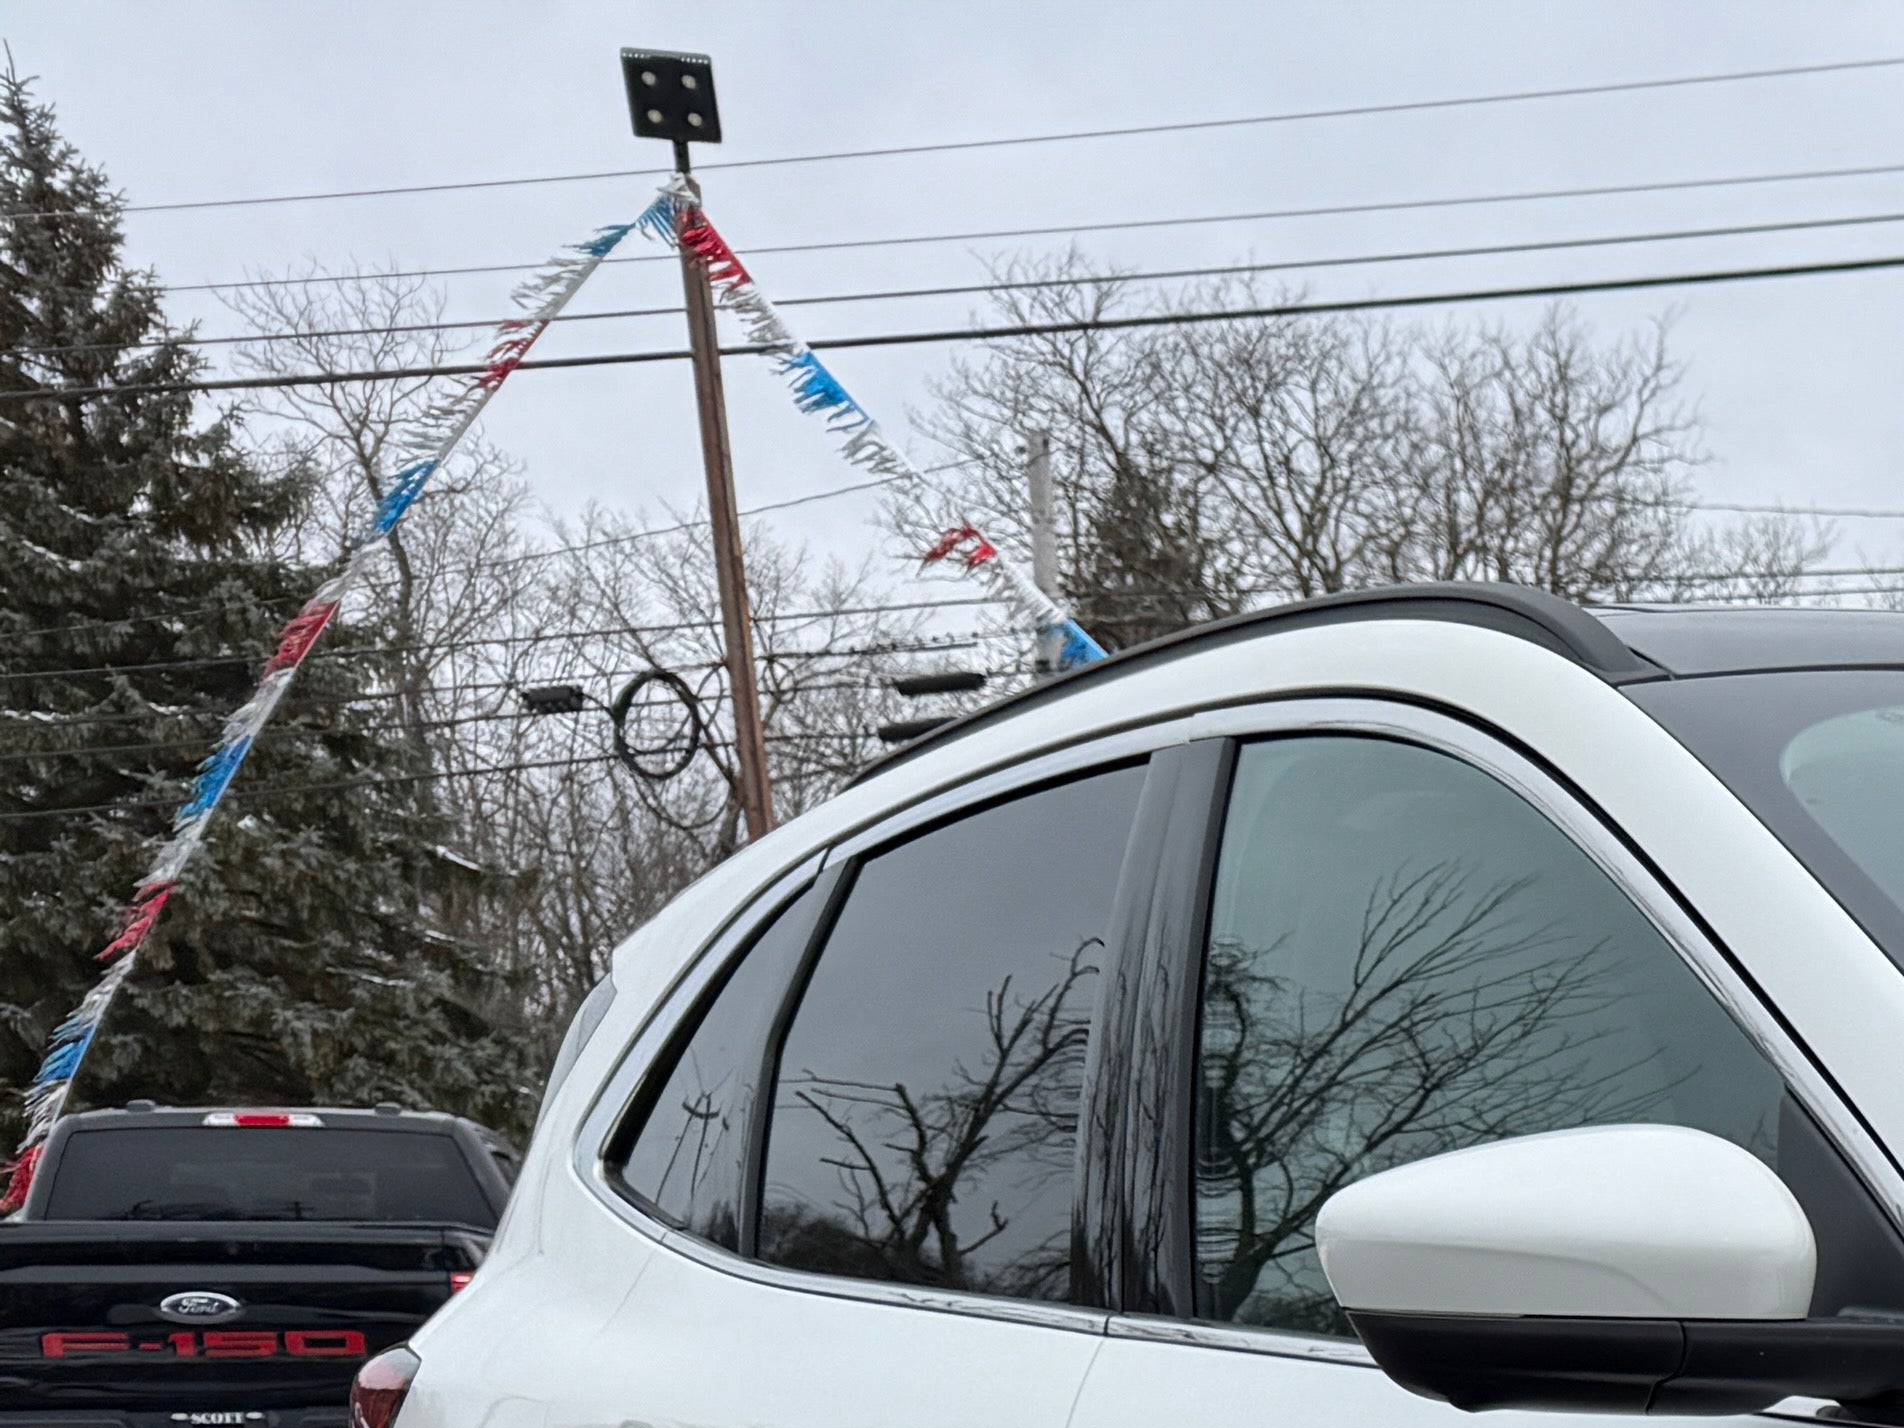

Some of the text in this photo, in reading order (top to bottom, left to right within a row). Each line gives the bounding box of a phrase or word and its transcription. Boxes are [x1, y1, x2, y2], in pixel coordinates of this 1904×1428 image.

[178, 1297, 219, 1313] Ford
[41, 1331, 367, 1359] F-150
[190, 1412, 245, 1424] SCOTT
